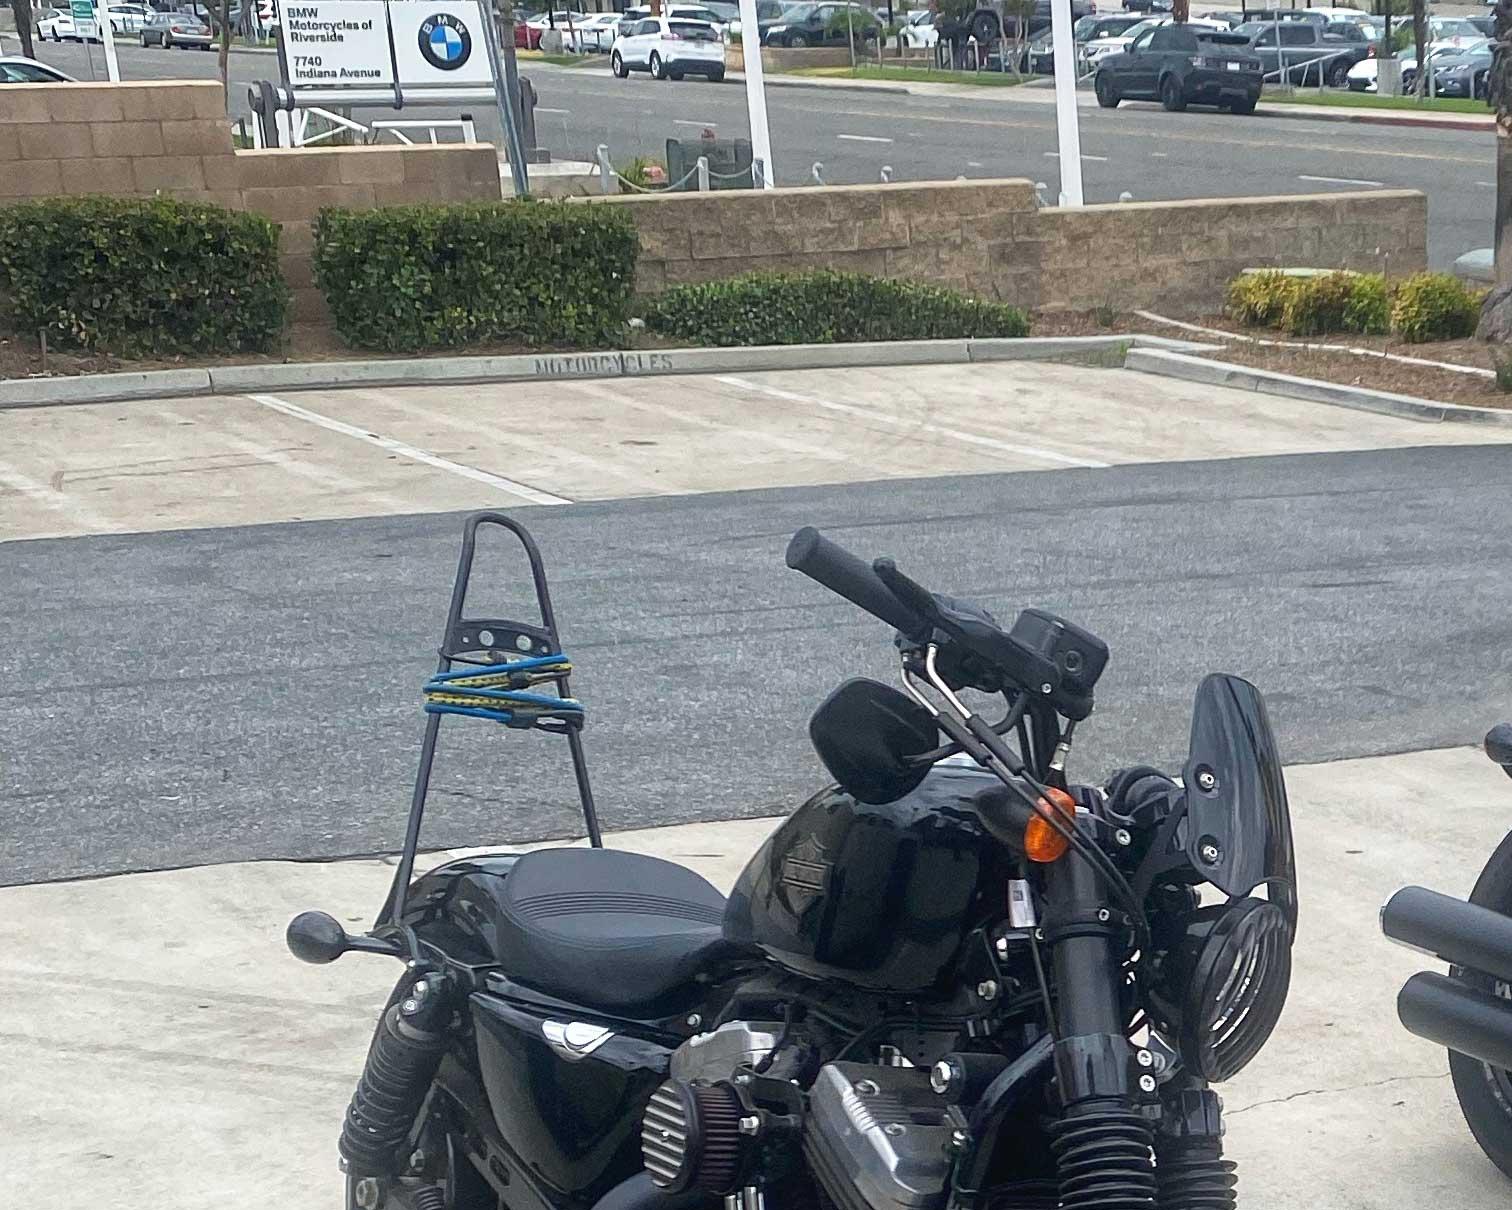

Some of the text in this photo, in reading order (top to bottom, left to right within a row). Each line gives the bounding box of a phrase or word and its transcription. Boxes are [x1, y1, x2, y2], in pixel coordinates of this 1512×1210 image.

[287, 8, 318, 18] BMW
[289, 20, 372, 35] Motorcycles of
[423, 15, 466, 35] BMW
[291, 32, 344, 42] Riverside
[294, 56, 322, 67] 7740
[295, 68, 381, 78] Indiana Avenue
